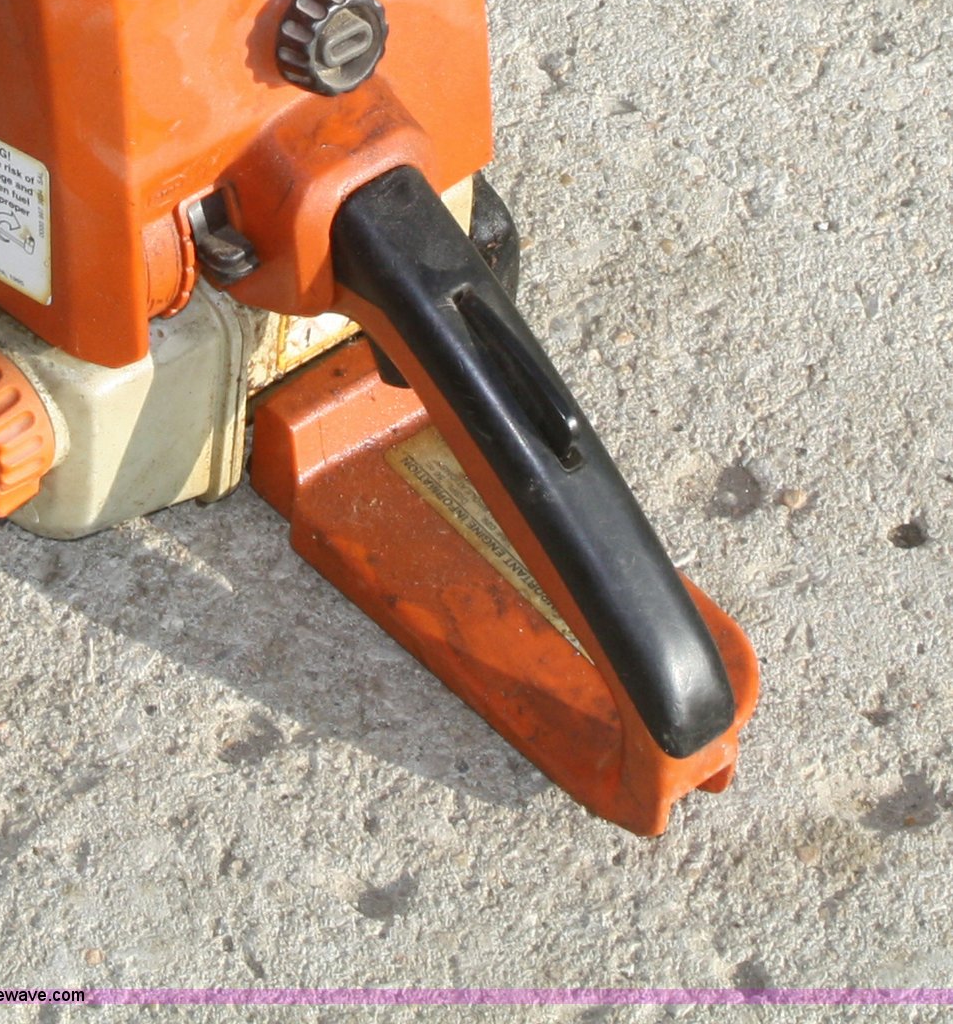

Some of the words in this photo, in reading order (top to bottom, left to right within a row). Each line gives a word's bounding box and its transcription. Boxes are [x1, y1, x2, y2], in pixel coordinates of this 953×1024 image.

[4, 163, 22, 178] risk
[24, 175, 35, 185] of
[12, 190, 30, 205] fuel
[15, 181, 33, 197] and
[401, 456, 469, 522] INFORMATION
[467, 519, 505, 558] ENGINE
